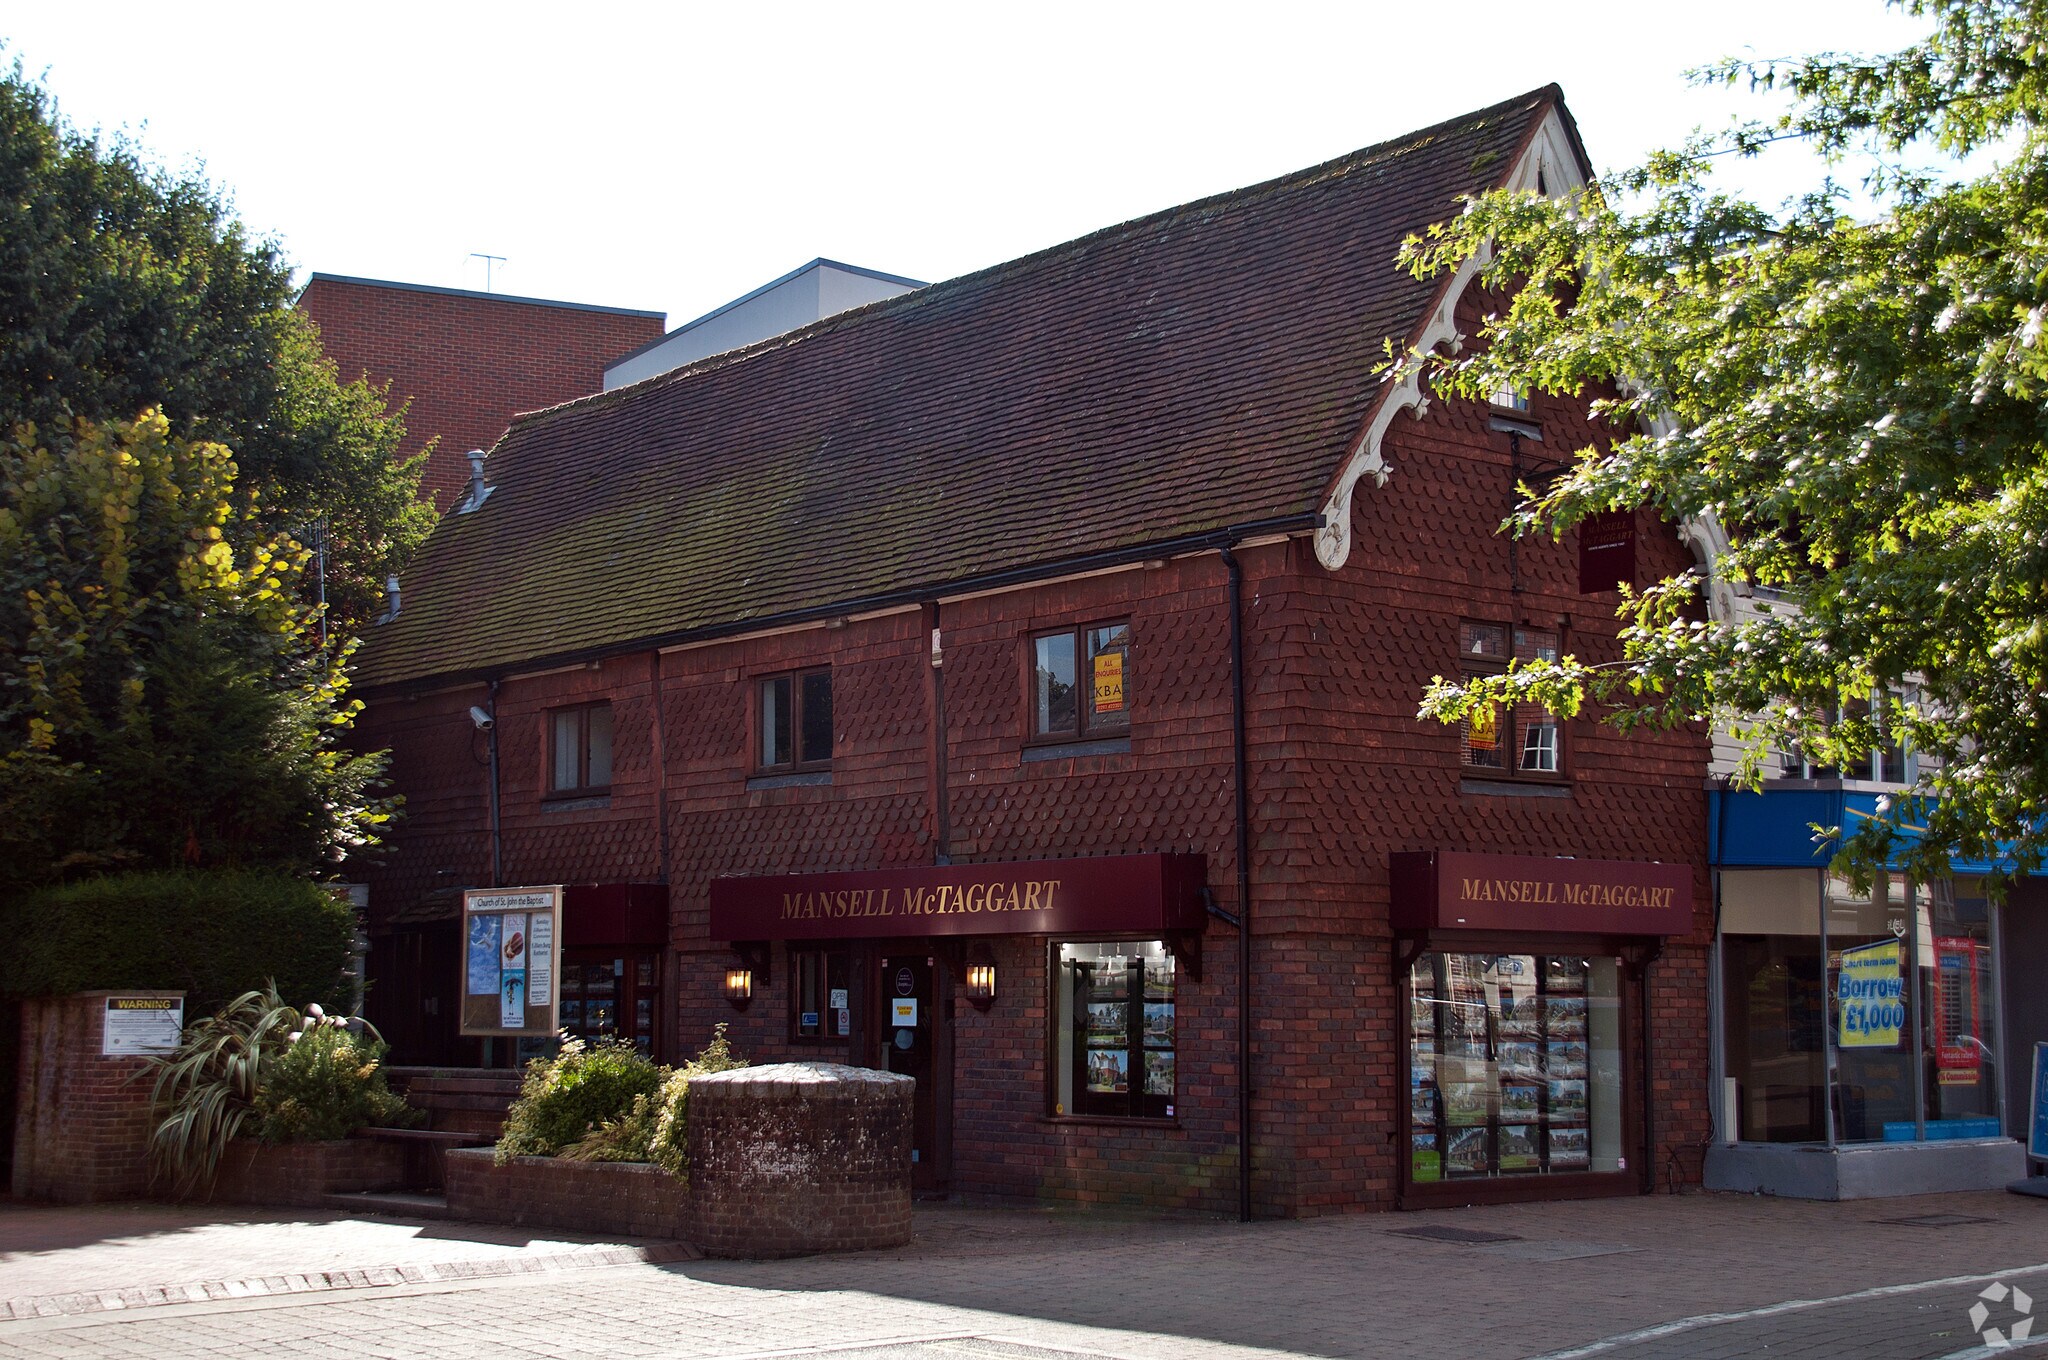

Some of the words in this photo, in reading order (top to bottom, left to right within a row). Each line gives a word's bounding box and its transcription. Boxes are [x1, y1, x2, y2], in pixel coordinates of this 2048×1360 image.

[1588, 521, 1627, 533] MANSELL
[1095, 668, 1121, 678] ENQUIRIES
[1095, 684, 1122, 698] KBA
[1459, 878, 1558, 904] MANSELL
[1561, 882, 1674, 908] McTAGGART
[477, 898, 494, 907] Church
[494, 898, 500, 906] of
[506, 897, 517, 907] John
[518, 897, 526, 905] the
[526, 896, 544, 906] Baptist
[779, 888, 895, 920] MANSELL
[899, 880, 1061, 916] McTAGGART
[1845, 959, 1862, 968] Short
[1863, 958, 1878, 967] term
[1879, 957, 1896, 966] loans
[1839, 973, 1903, 999] Borrow
[118, 1000, 171, 1009] WARNING
[1846, 1004, 1904, 1035] £1,000
[1941, 1050, 1960, 1059] Fantastic
